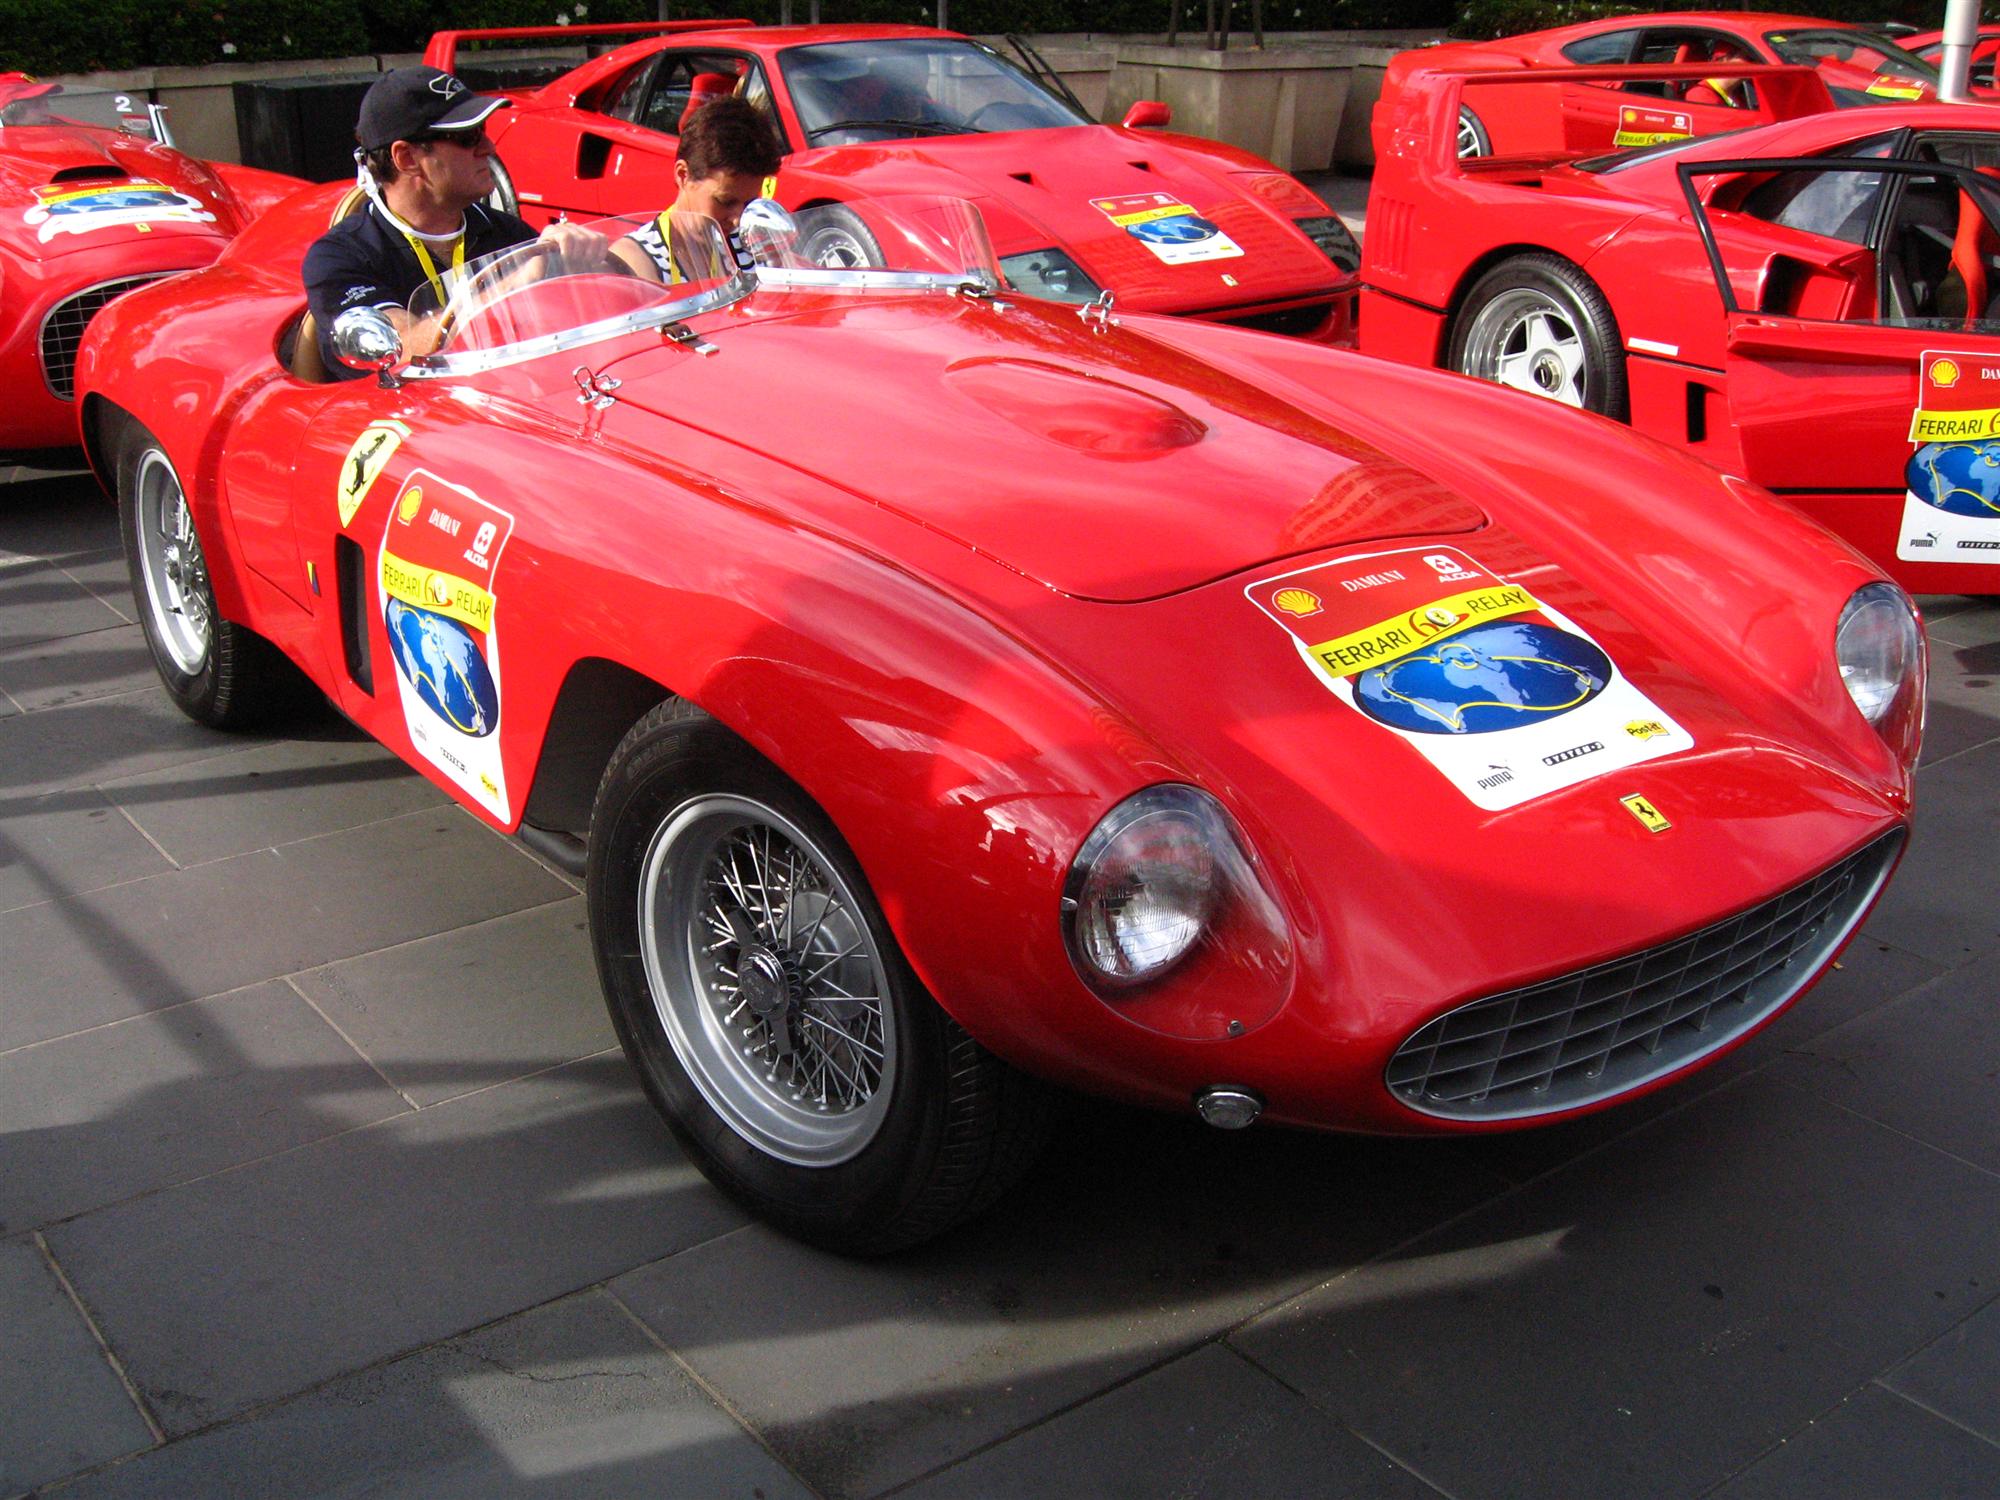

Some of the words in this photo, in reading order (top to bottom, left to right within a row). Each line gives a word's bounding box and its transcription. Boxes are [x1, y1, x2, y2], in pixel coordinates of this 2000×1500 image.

[115, 96, 132, 112] 2
[1919, 419, 1984, 435] FERRARI
[1341, 569, 1406, 592] DAMIANI
[1438, 571, 1482, 583] ALCOA
[384, 563, 421, 598] FERRARI
[456, 590, 490, 621] RELAY
[1321, 628, 1412, 669] FERRARI
[1466, 591, 1526, 614] RELAY
[1477, 771, 1514, 790] PUMA
